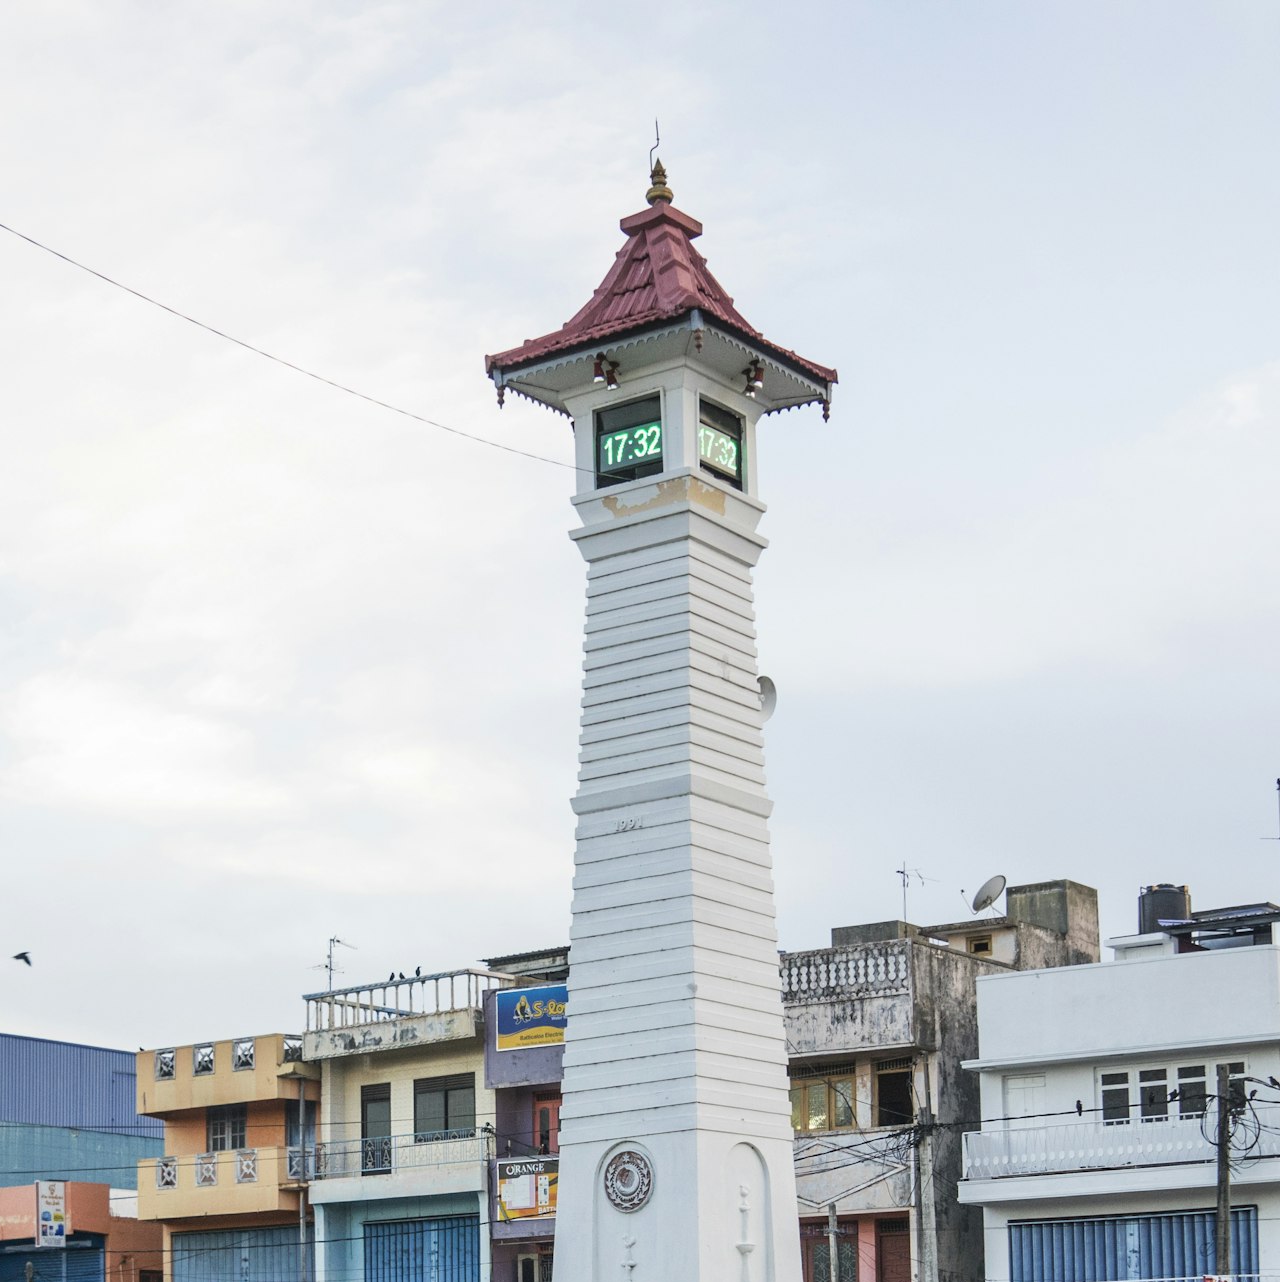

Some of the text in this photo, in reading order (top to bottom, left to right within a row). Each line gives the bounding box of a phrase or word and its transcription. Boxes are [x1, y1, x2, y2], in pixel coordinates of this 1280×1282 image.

[604, 424, 661, 466] 17:32
[699, 427, 738, 471] 17:32
[532, 1000, 566, 1018] S-lo
[506, 1163, 545, 1176] ORANGE
